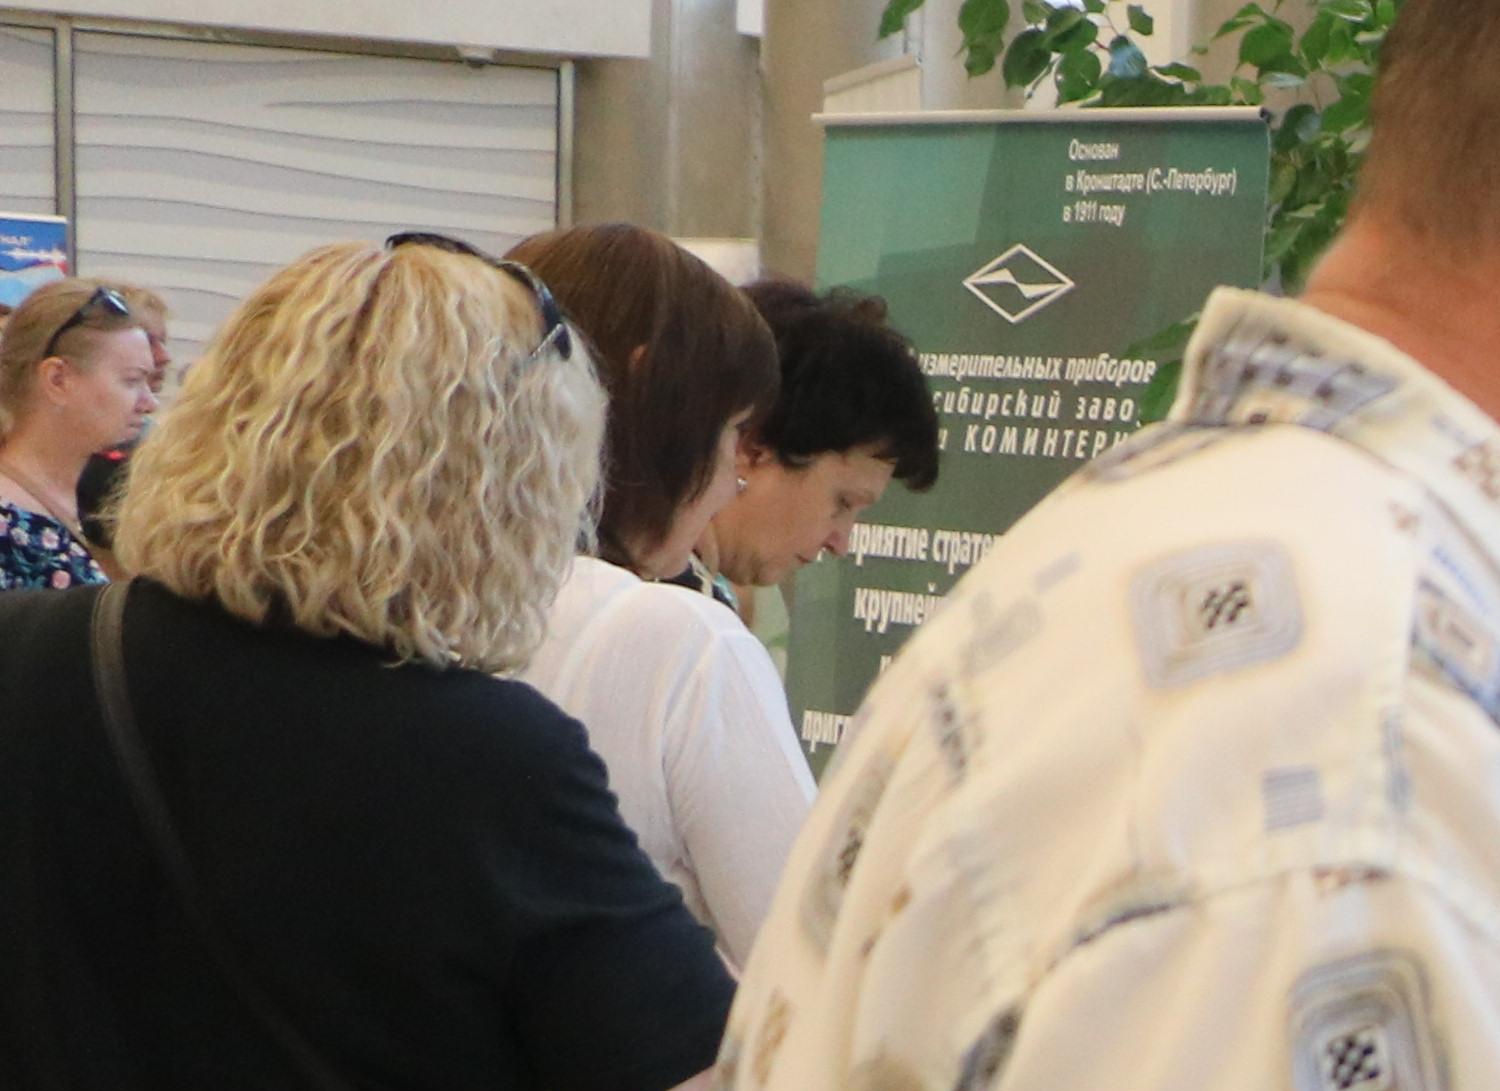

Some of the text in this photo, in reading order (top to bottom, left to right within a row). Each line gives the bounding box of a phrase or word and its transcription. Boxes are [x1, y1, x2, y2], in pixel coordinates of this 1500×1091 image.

[1068, 138, 1119, 161] Основан
[1065, 167, 1237, 196] в Кронштадте (С.-Петербург)
[1062, 200, 1126, 227] в 1911 году
[932, 386, 1142, 428] сибирский заво
[963, 424, 1130, 460] КОМИНТЕРН
